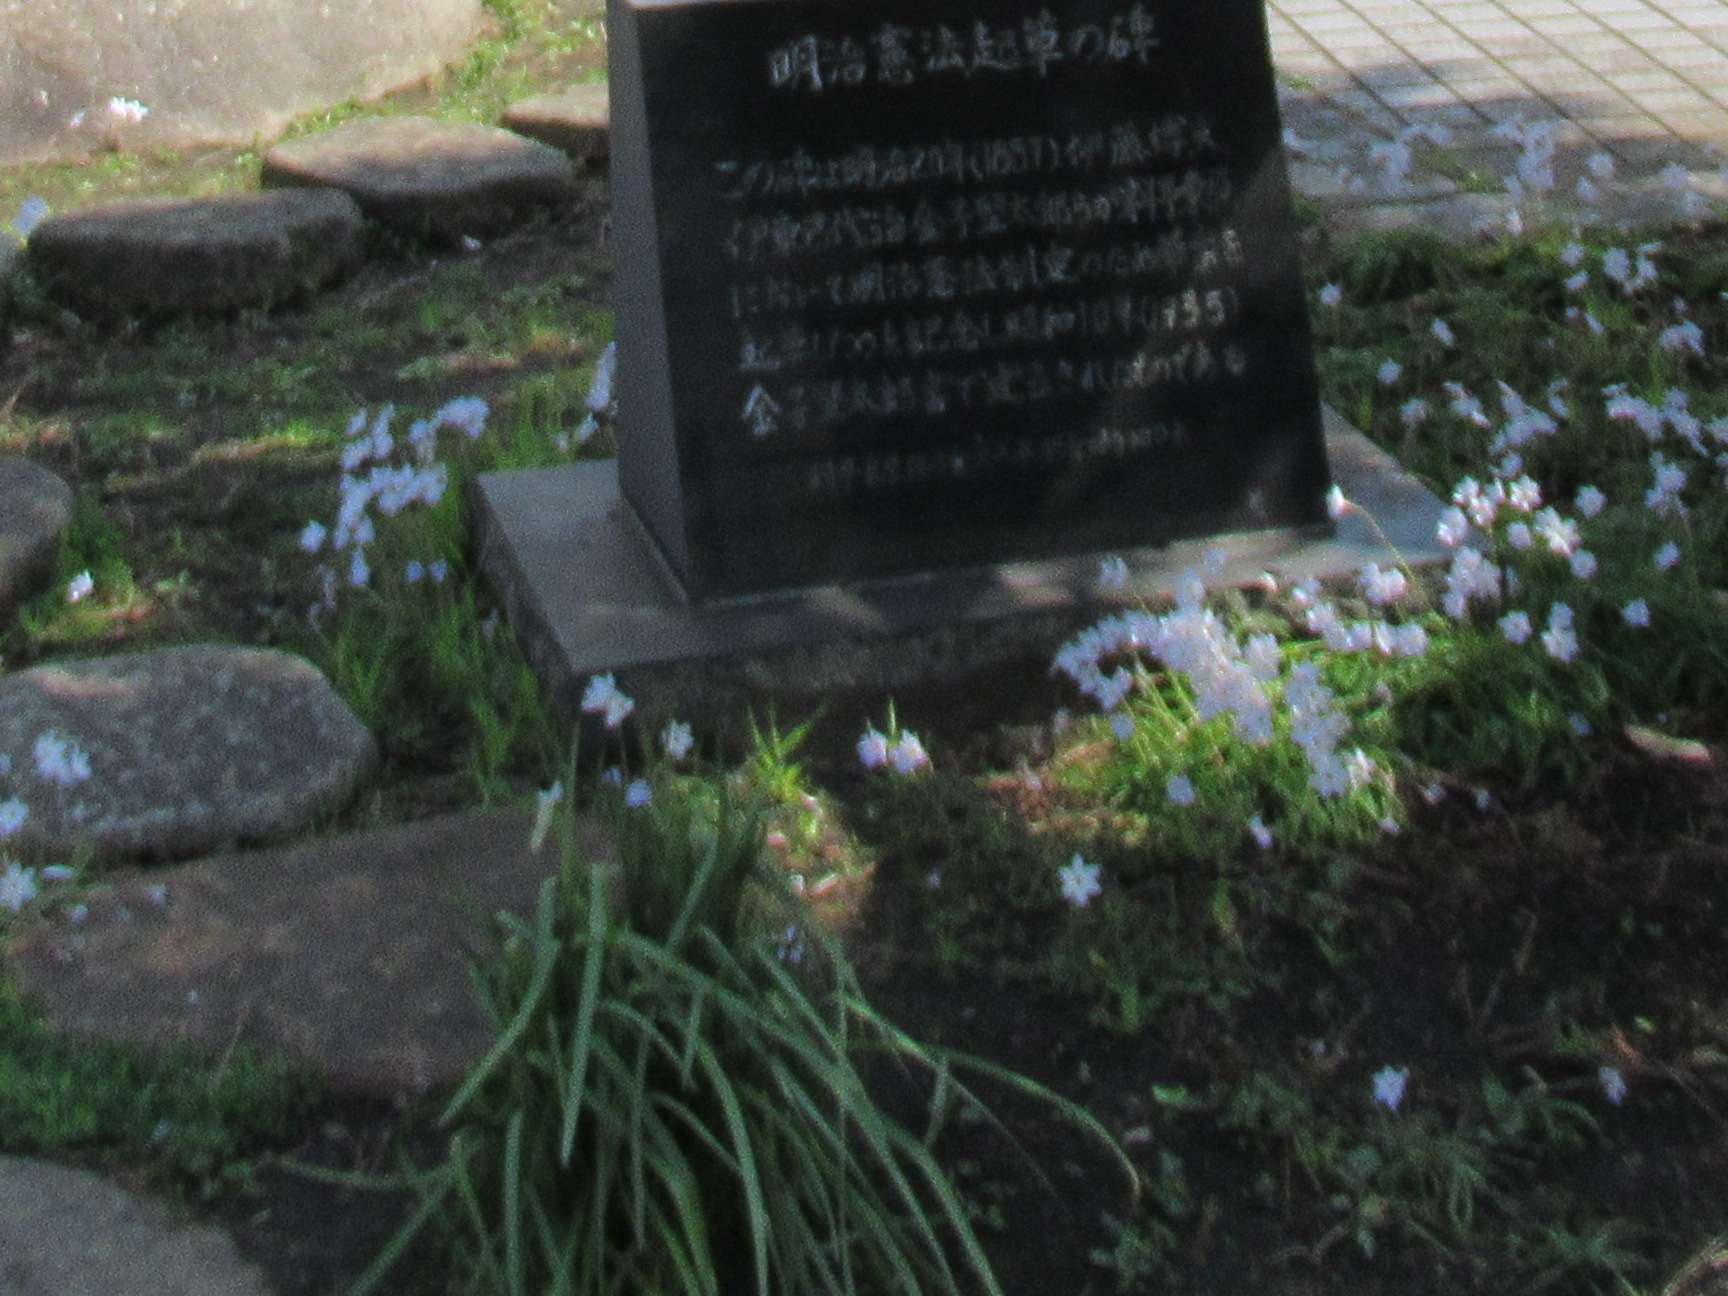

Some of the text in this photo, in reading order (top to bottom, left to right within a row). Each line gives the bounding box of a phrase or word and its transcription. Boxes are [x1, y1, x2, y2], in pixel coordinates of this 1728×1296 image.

[769, 5, 1161, 92] 明治憲法起草の碑
